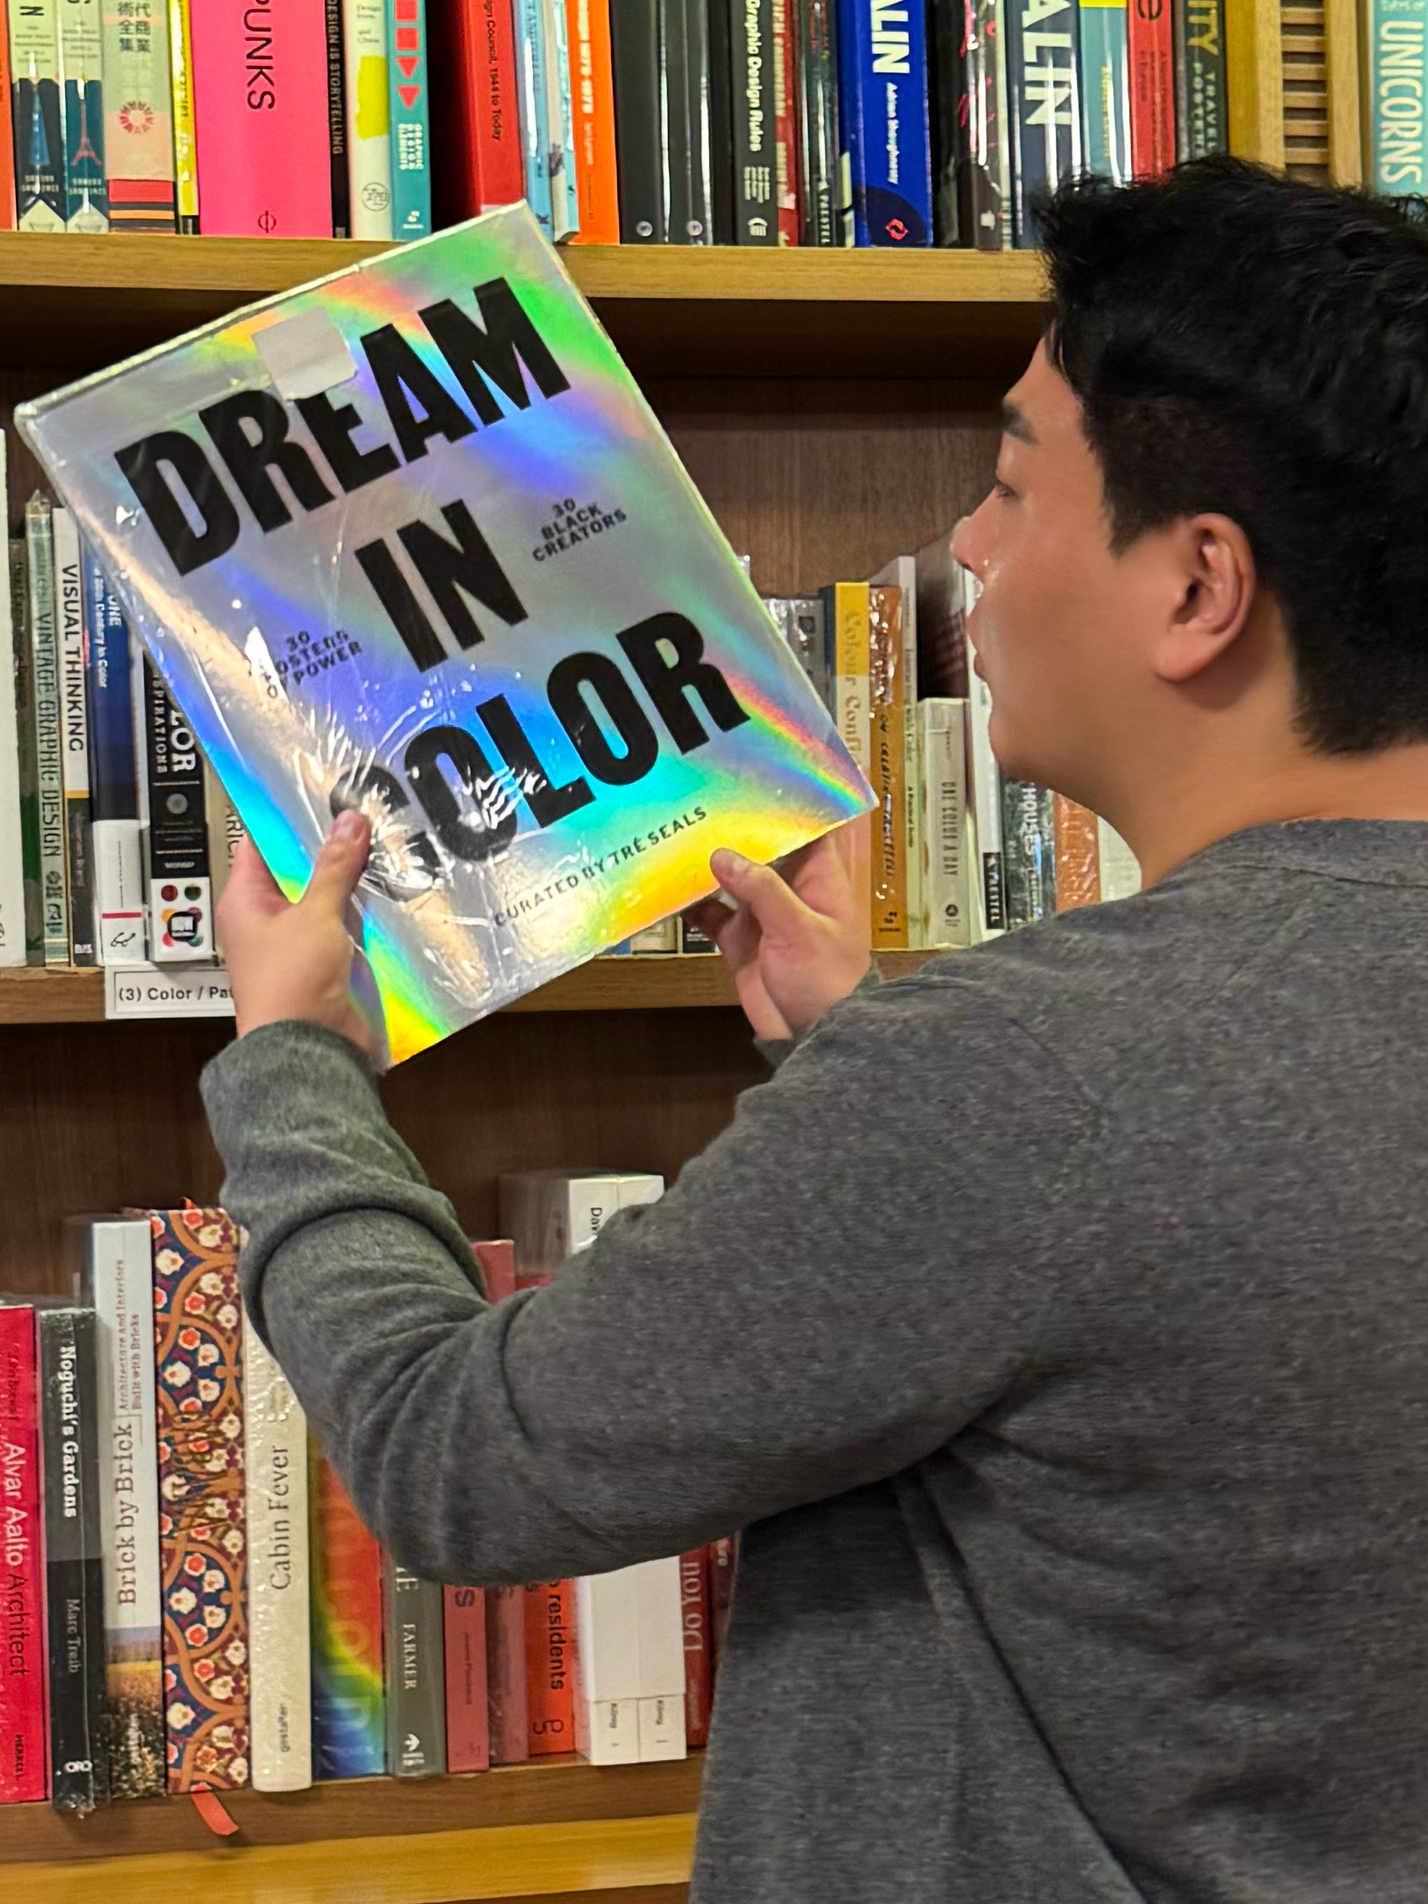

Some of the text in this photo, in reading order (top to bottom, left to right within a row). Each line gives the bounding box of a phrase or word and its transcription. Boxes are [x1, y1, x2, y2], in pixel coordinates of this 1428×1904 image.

[1379, 21, 1424, 184] UNICORNS
[115, 275, 570, 577] DREAM
[532, 508, 627, 562] CREATORS
[540, 503, 603, 541] BLACK
[553, 498, 577, 518] 30
[285, 630, 312, 652] 30
[355, 498, 529, 674] IN
[61, 563, 88, 752] VISUAL THINKING
[272, 629, 351, 680] OSTERS
[293, 641, 363, 686] POWER
[329, 611, 750, 897] COLOR
[493, 806, 708, 927] CURATED BY TRÉ SEALS
[119, 986, 194, 1002] (3) Color
[58, 1345, 78, 1519] Noguchi's Gardens
[3, 1441, 30, 1676] Alvar Aalto Architect
[268, 1444, 293, 1591] Cabin Fever
[403, 1623, 417, 1691] FARMER
